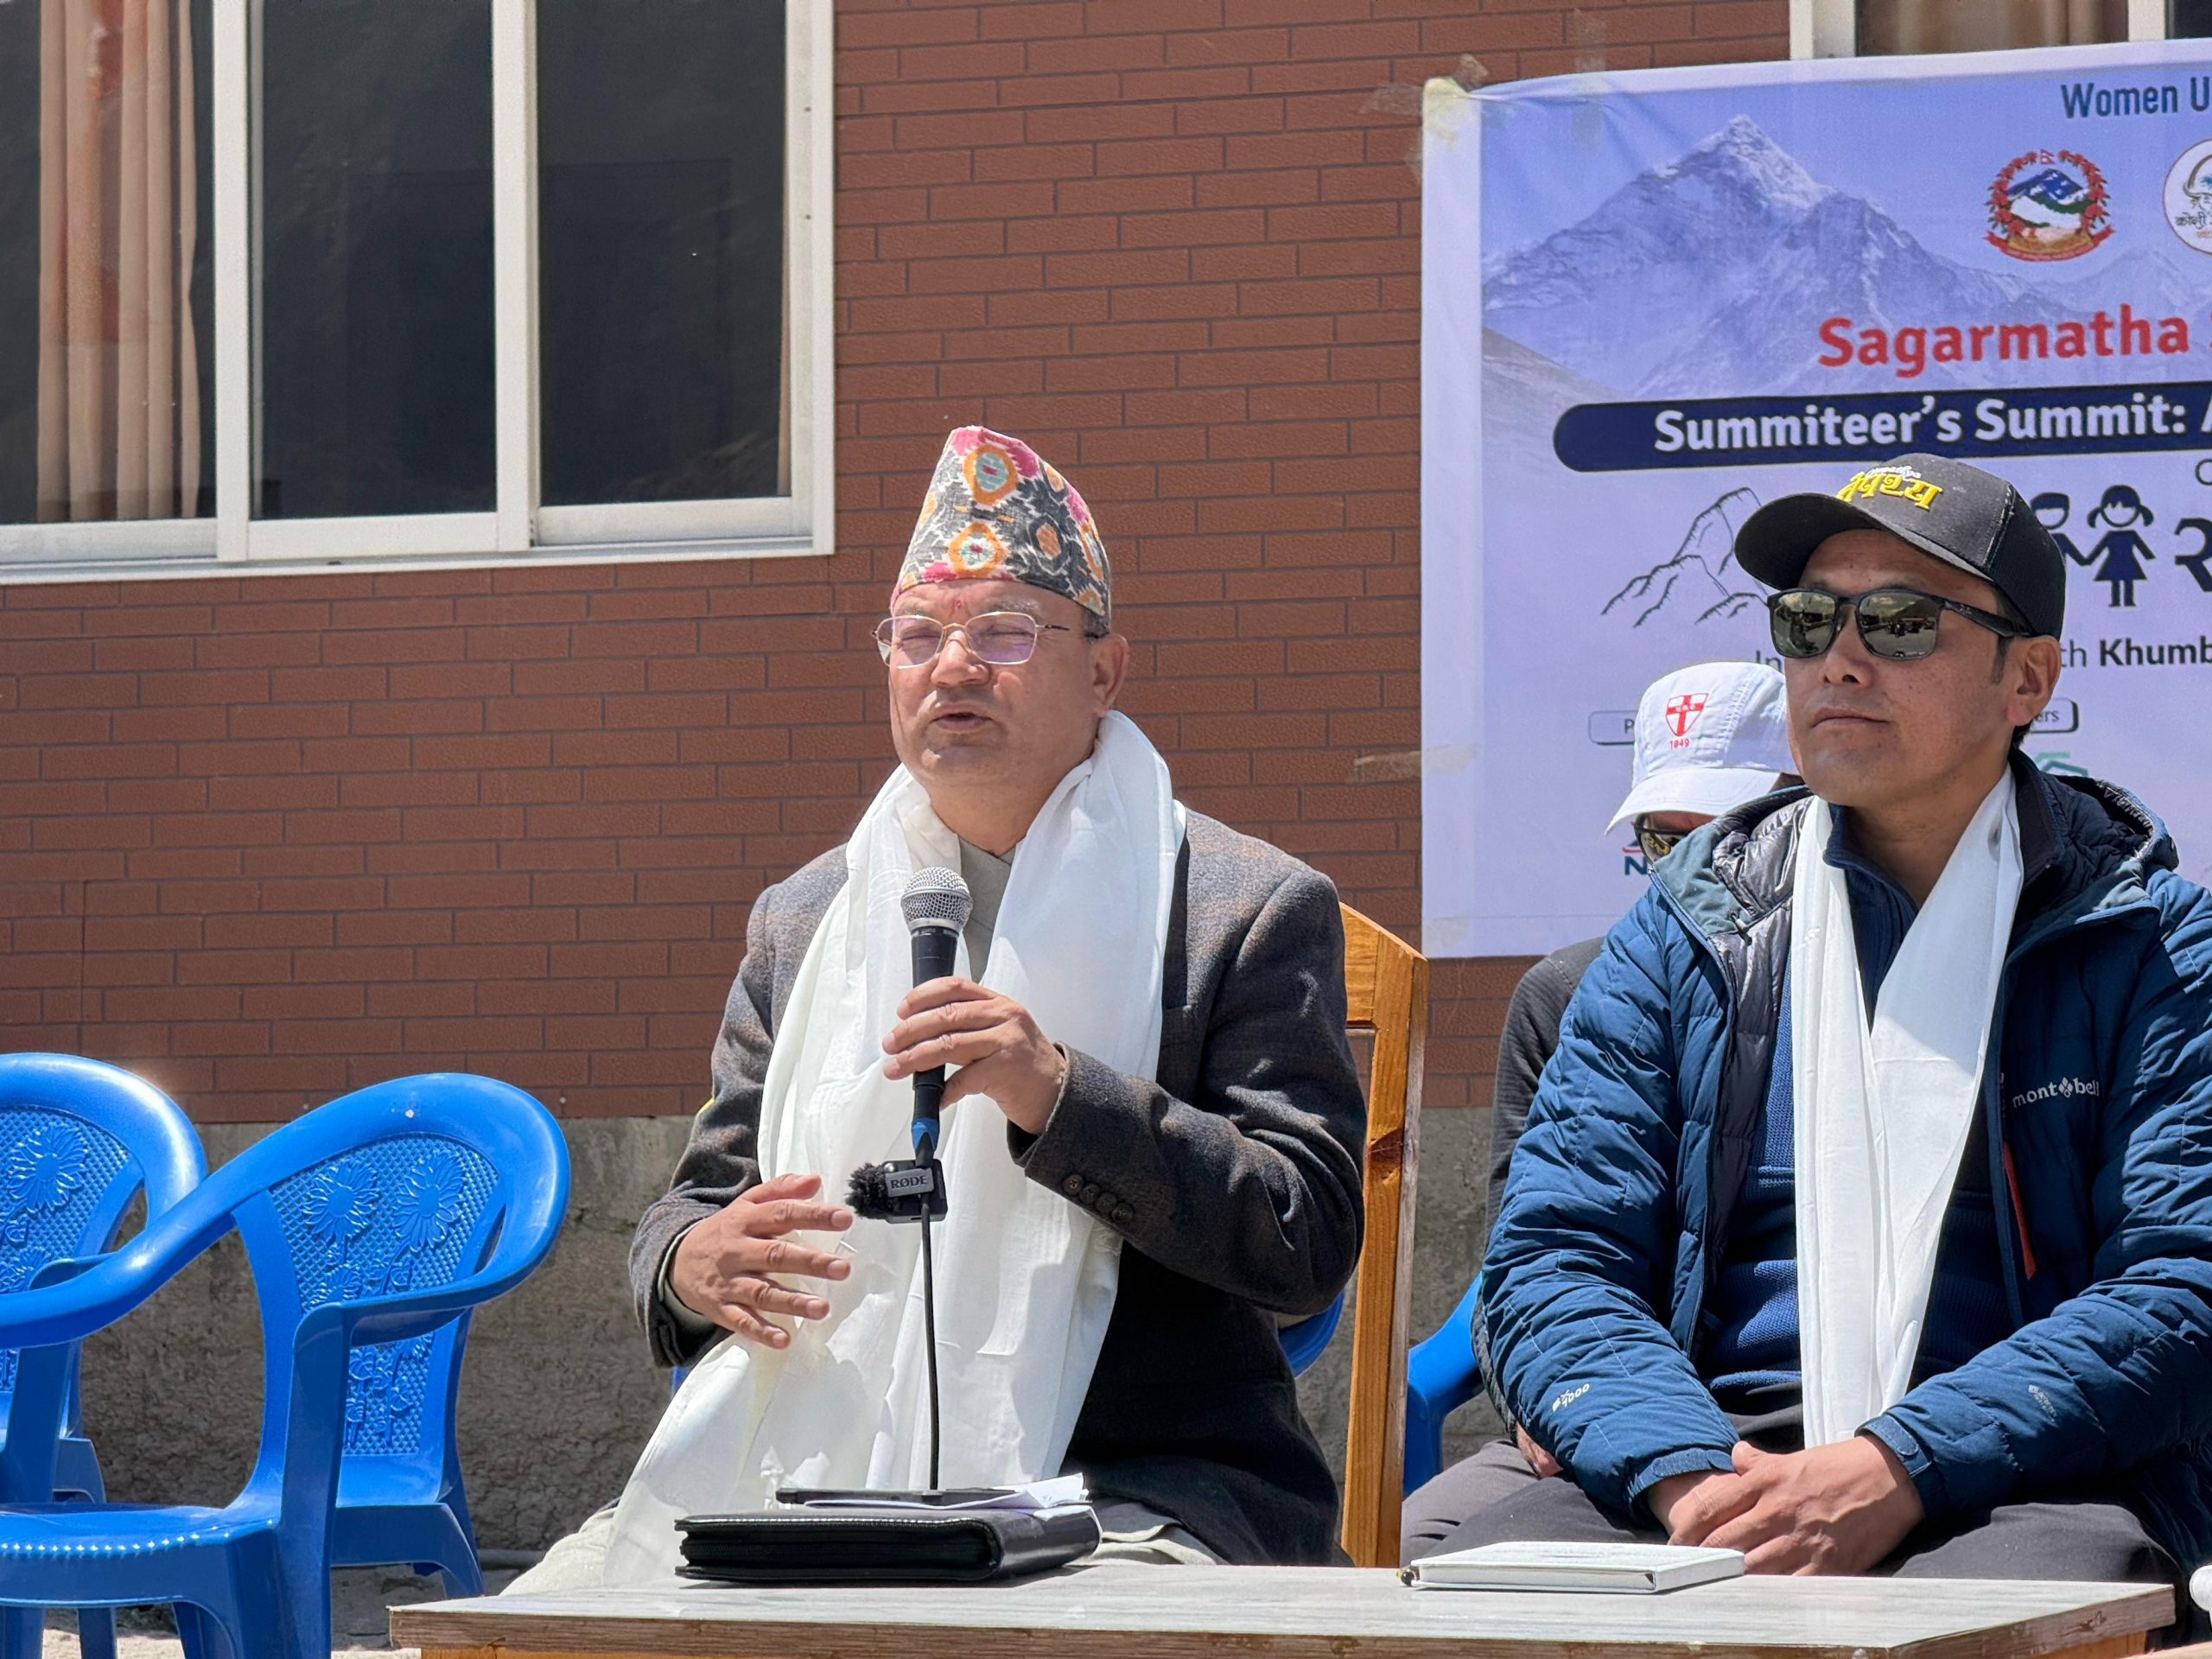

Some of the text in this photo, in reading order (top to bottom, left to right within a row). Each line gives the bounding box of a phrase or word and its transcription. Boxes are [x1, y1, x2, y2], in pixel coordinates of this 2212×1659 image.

[2060, 82, 2178, 119] Women
[1818, 303, 2190, 378] Sagarmatha
[1654, 395, 1962, 452] Summiteer’s
[1975, 391, 2186, 442] Summit:
[890, 1175, 927, 1189] RØDE
